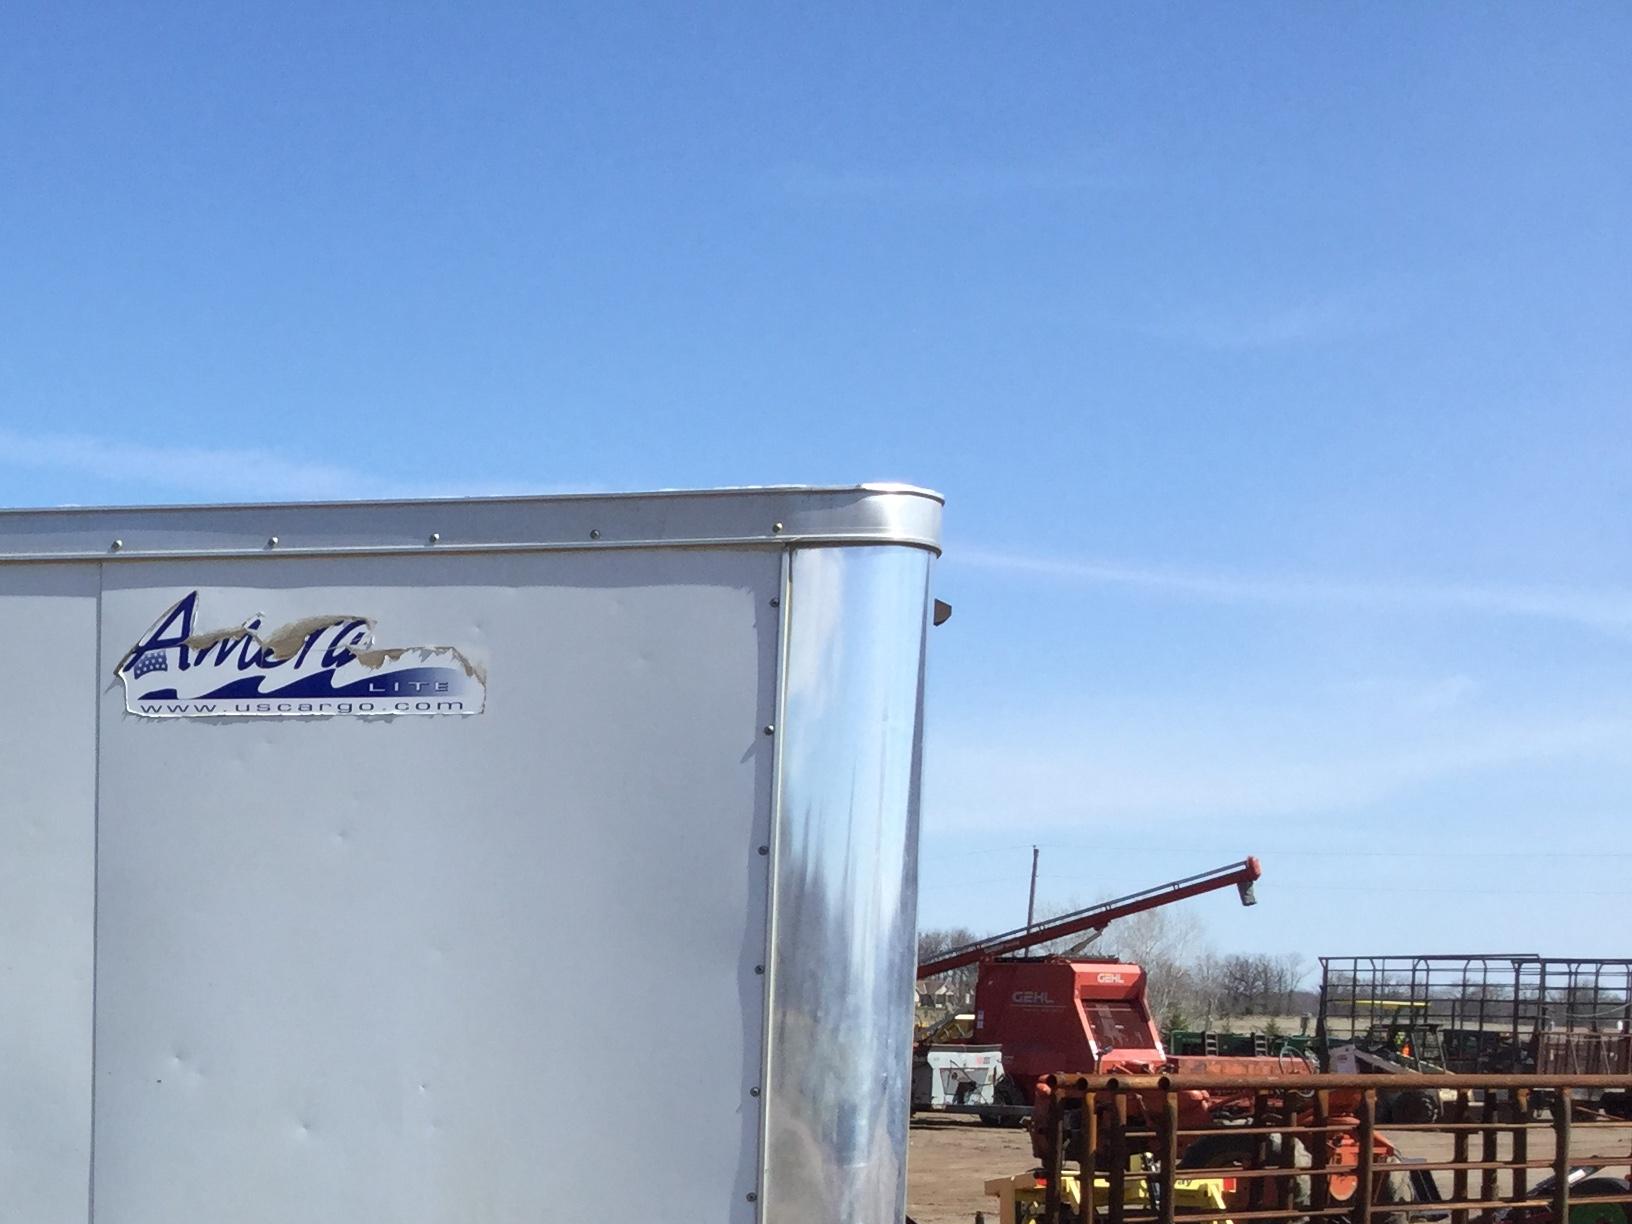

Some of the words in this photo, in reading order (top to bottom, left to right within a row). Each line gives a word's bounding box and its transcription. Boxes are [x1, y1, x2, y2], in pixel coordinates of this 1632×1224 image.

[368, 681, 449, 693] LITE
[140, 699, 464, 714] www.uscargo.com
[1096, 972, 1126, 984] GEHL
[1011, 991, 1056, 1004] GEHL
